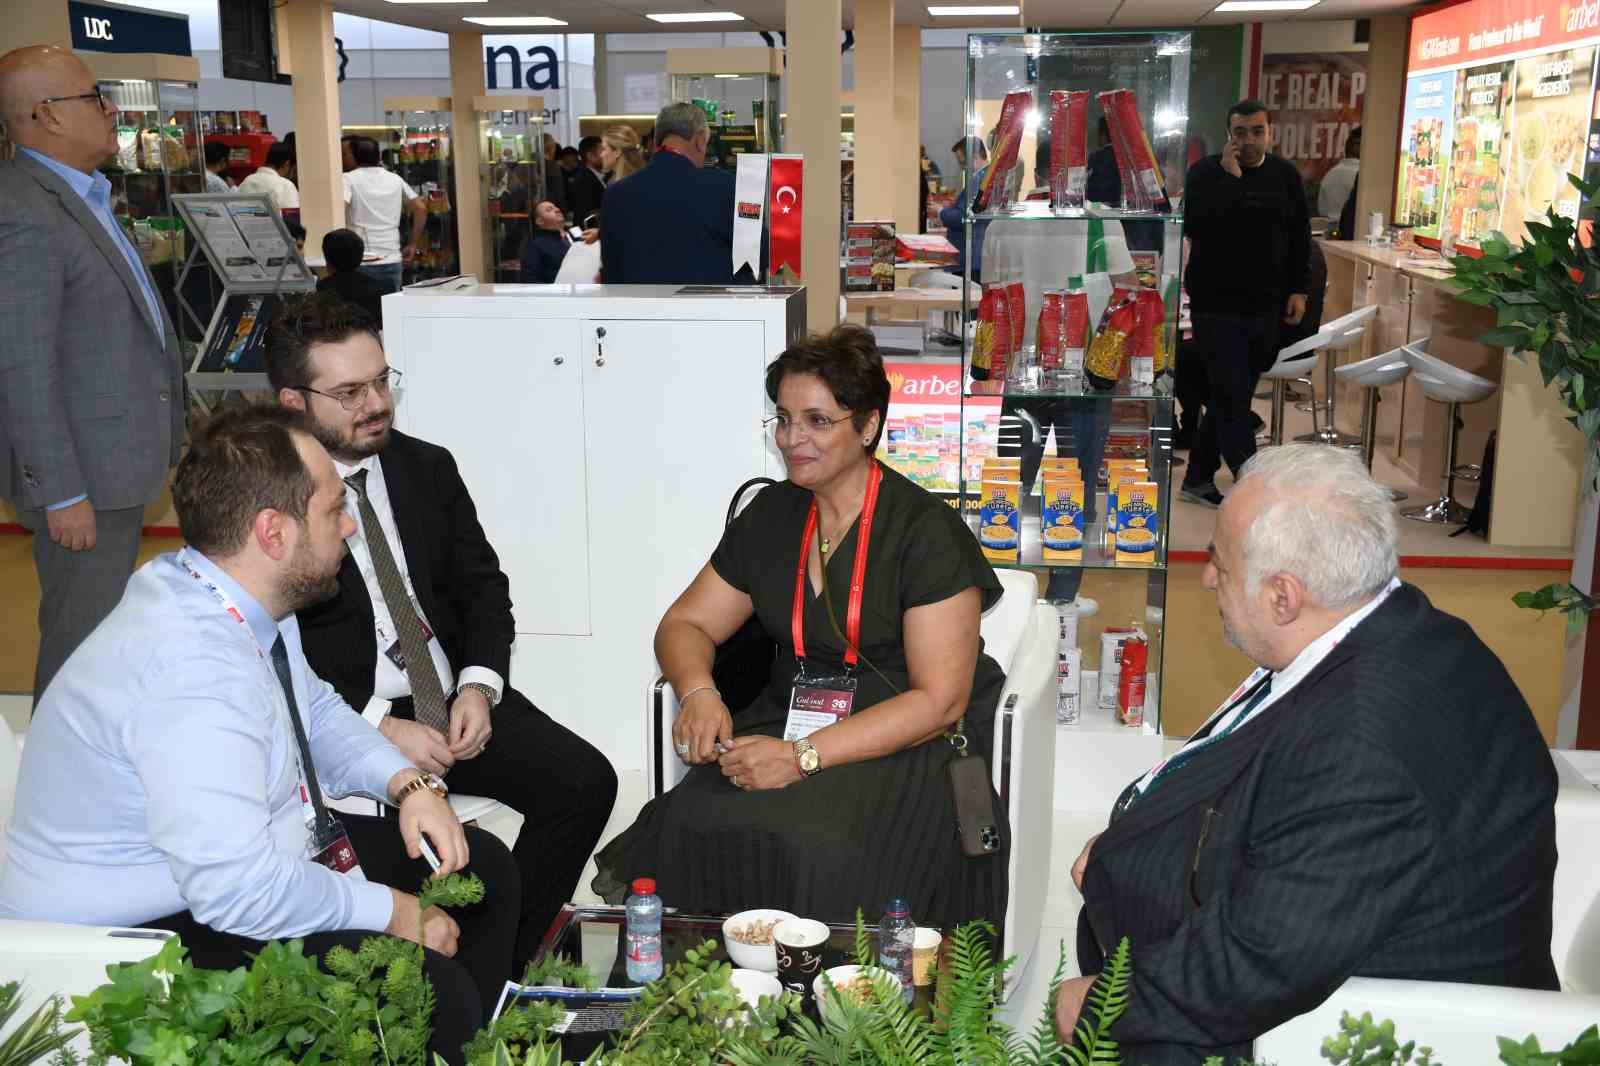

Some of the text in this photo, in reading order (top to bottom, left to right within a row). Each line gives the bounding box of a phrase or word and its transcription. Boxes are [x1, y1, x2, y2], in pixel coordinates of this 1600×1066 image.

[486, 45, 560, 91] na
[1288, 72, 1343, 110] REAL
[903, 375, 962, 396] arbe
